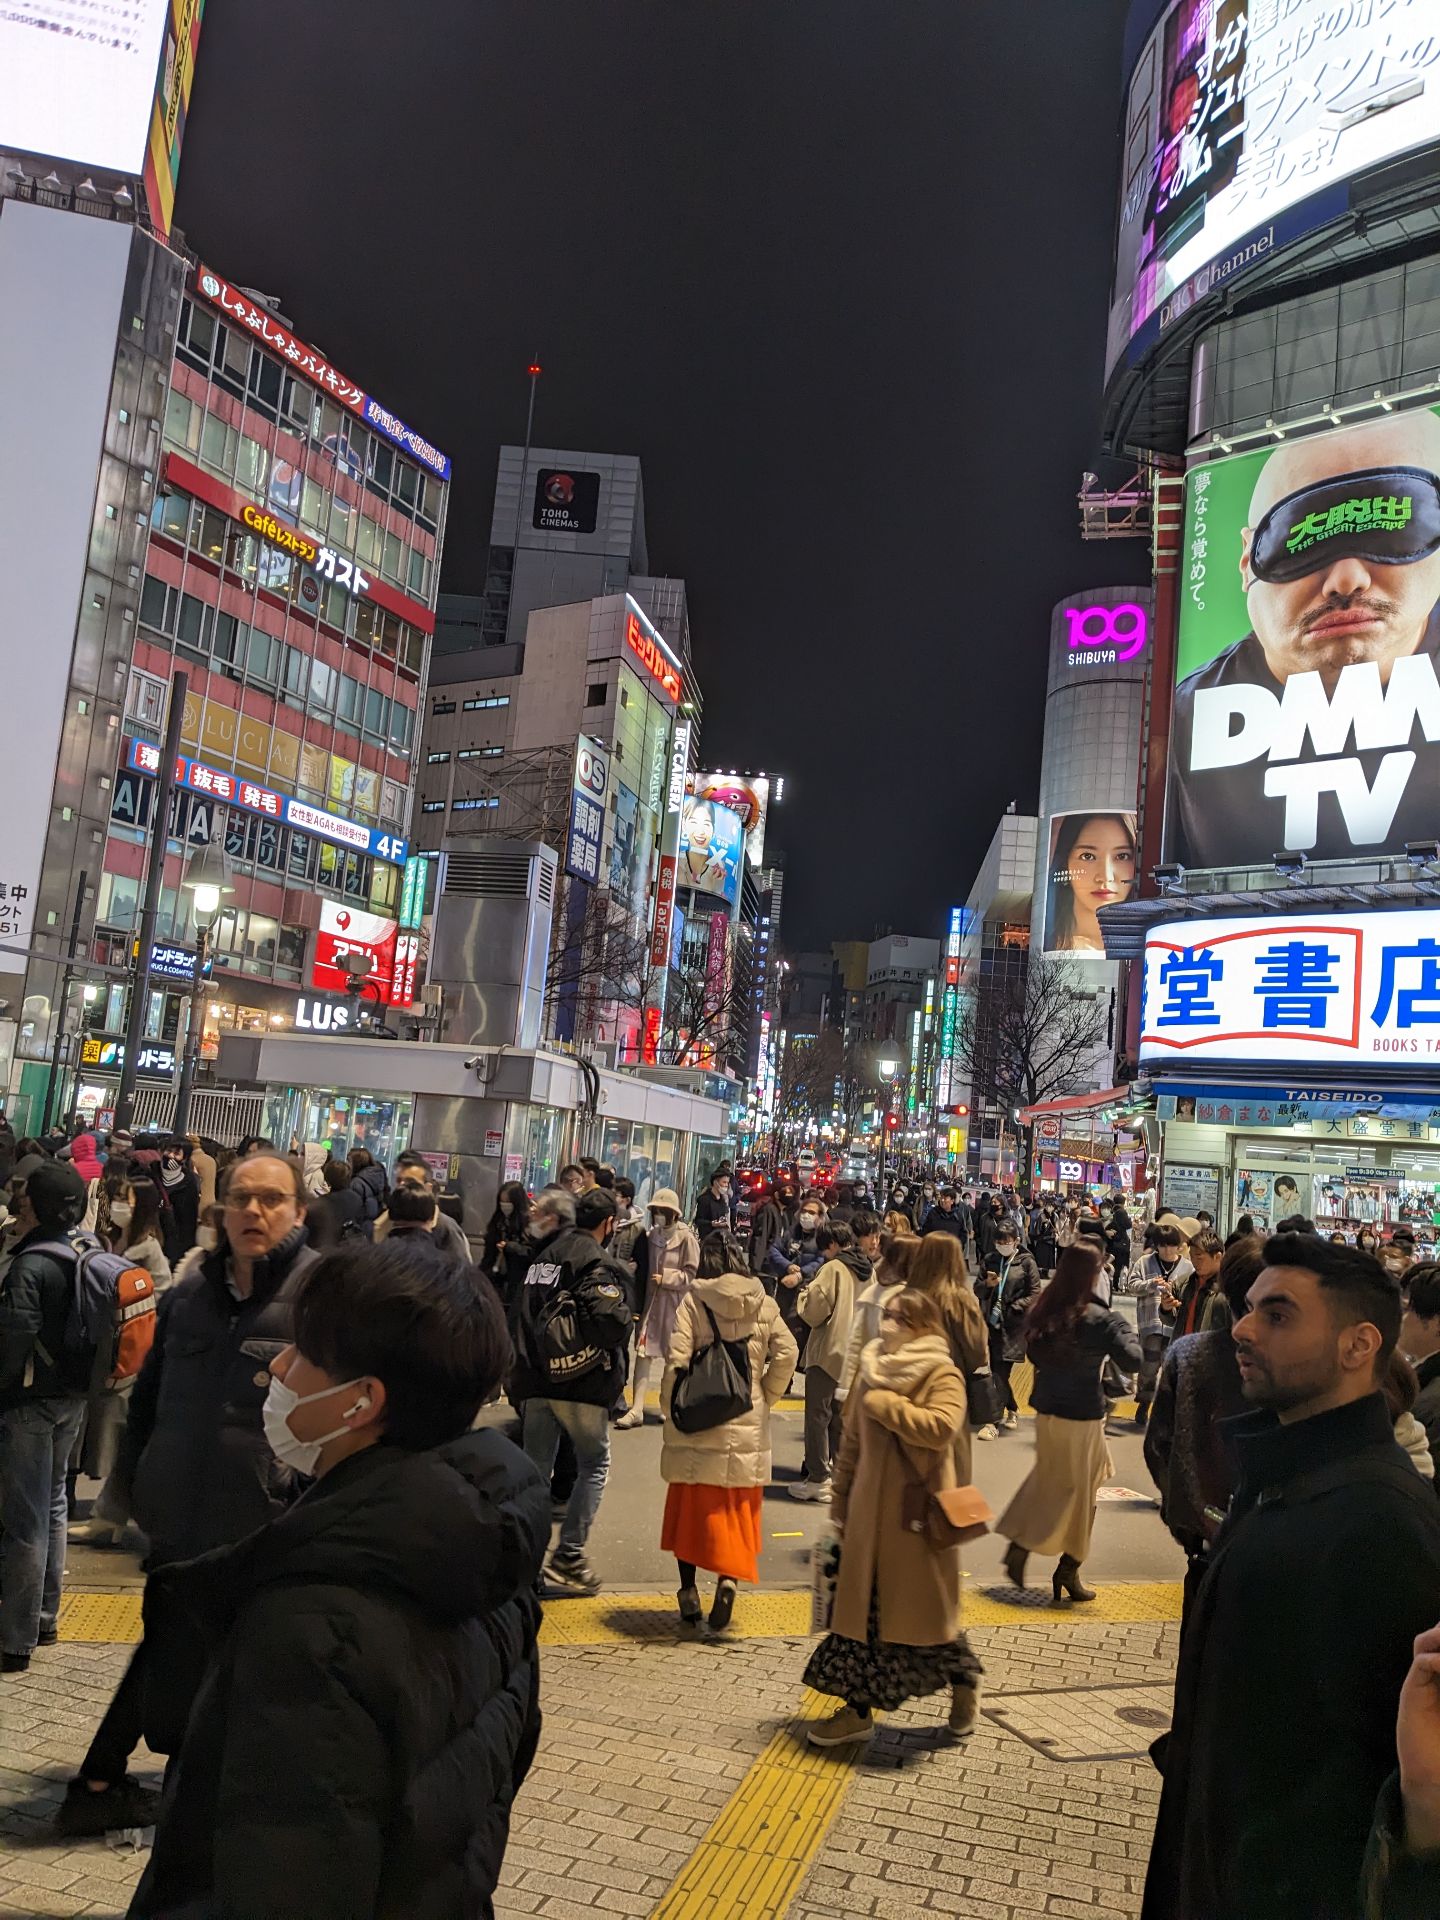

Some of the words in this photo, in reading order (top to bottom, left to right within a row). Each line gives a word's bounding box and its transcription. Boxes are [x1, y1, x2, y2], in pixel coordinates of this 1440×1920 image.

[1158, 281, 1196, 329] DHC
[1194, 226, 1275, 295] Channel
[220, 284, 364, 406] しゃぶしゃぶバイキング
[540, 517, 580, 528] CINEMAS
[541, 508, 569, 519] TOHO
[1286, 495, 1413, 548] 大脱出
[1289, 536, 1315, 554] THE
[1316, 522, 1355, 542] GREAT
[1355, 519, 1407, 534] ESCAPE
[1189, 471, 1212, 610] 夢なら覚めて。
[316, 546, 370, 594] ガスト
[1064, 603, 1147, 661] 109
[627, 612, 683, 704] ビックカメラ
[1068, 650, 1116, 665] SHIBUYA
[673, 726, 687, 752] BIC
[578, 747, 606, 796] OS
[667, 754, 684, 814] CAMERA
[194, 765, 231, 798] 抜毛
[243, 786, 278, 814] 発毛
[376, 835, 404, 860] 4F
[574, 797, 600, 842] 調剤
[1264, 750, 1417, 851] TV
[571, 832, 598, 878] 薬局
[661, 866, 673, 890] 免税
[393, 964, 404, 992] アコム
[1140, 937, 1440, 1034] 堂書店
[1373, 1038, 1418, 1052] BOOKS
[1286, 1090, 1383, 1102] TAISEIDO
[1326, 1117, 1440, 1138] 大盛堂書
